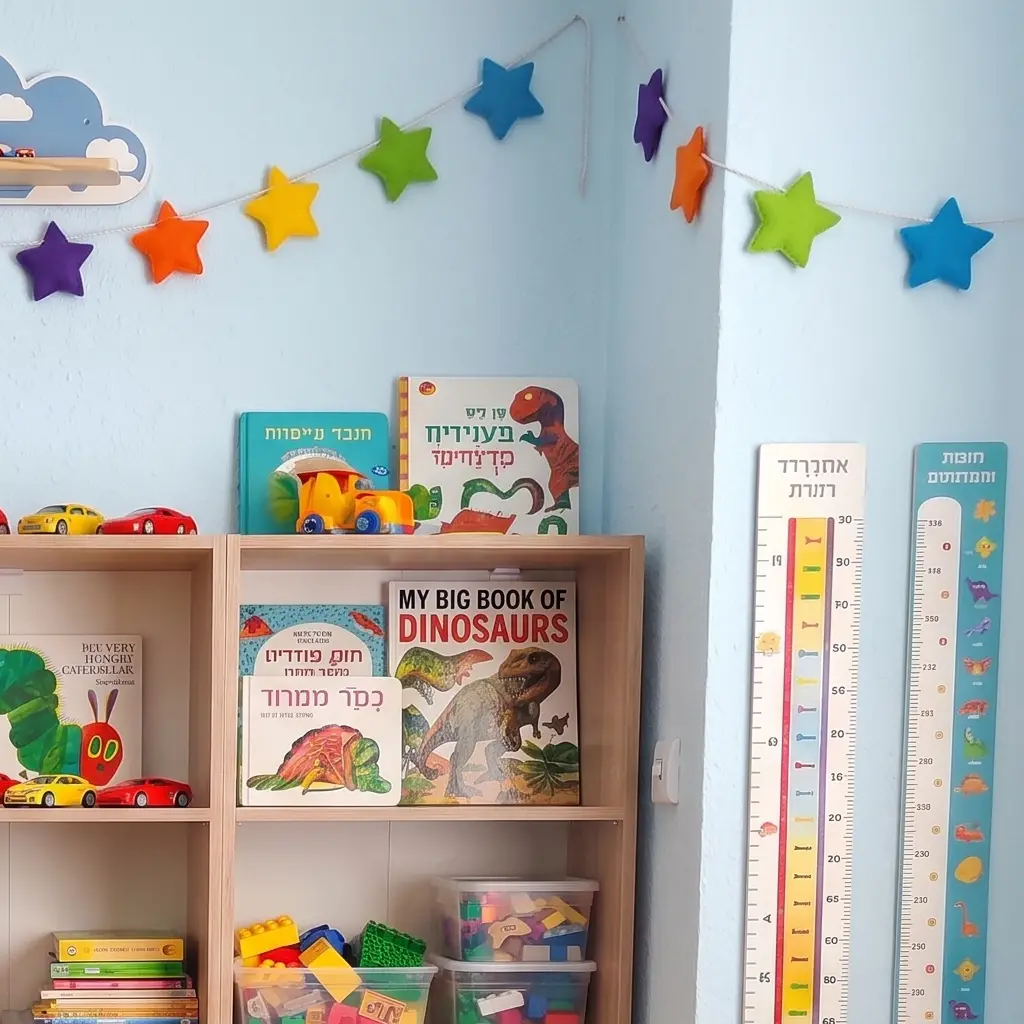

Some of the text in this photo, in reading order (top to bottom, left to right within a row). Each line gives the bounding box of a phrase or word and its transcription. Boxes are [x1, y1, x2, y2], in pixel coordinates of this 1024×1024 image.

[399, 589, 567, 610] MY BIG BOOK OF
[399, 613, 569, 644] DINOSAURS
[106, 643, 135, 652] VERY
[831, 730, 844, 738] 20
